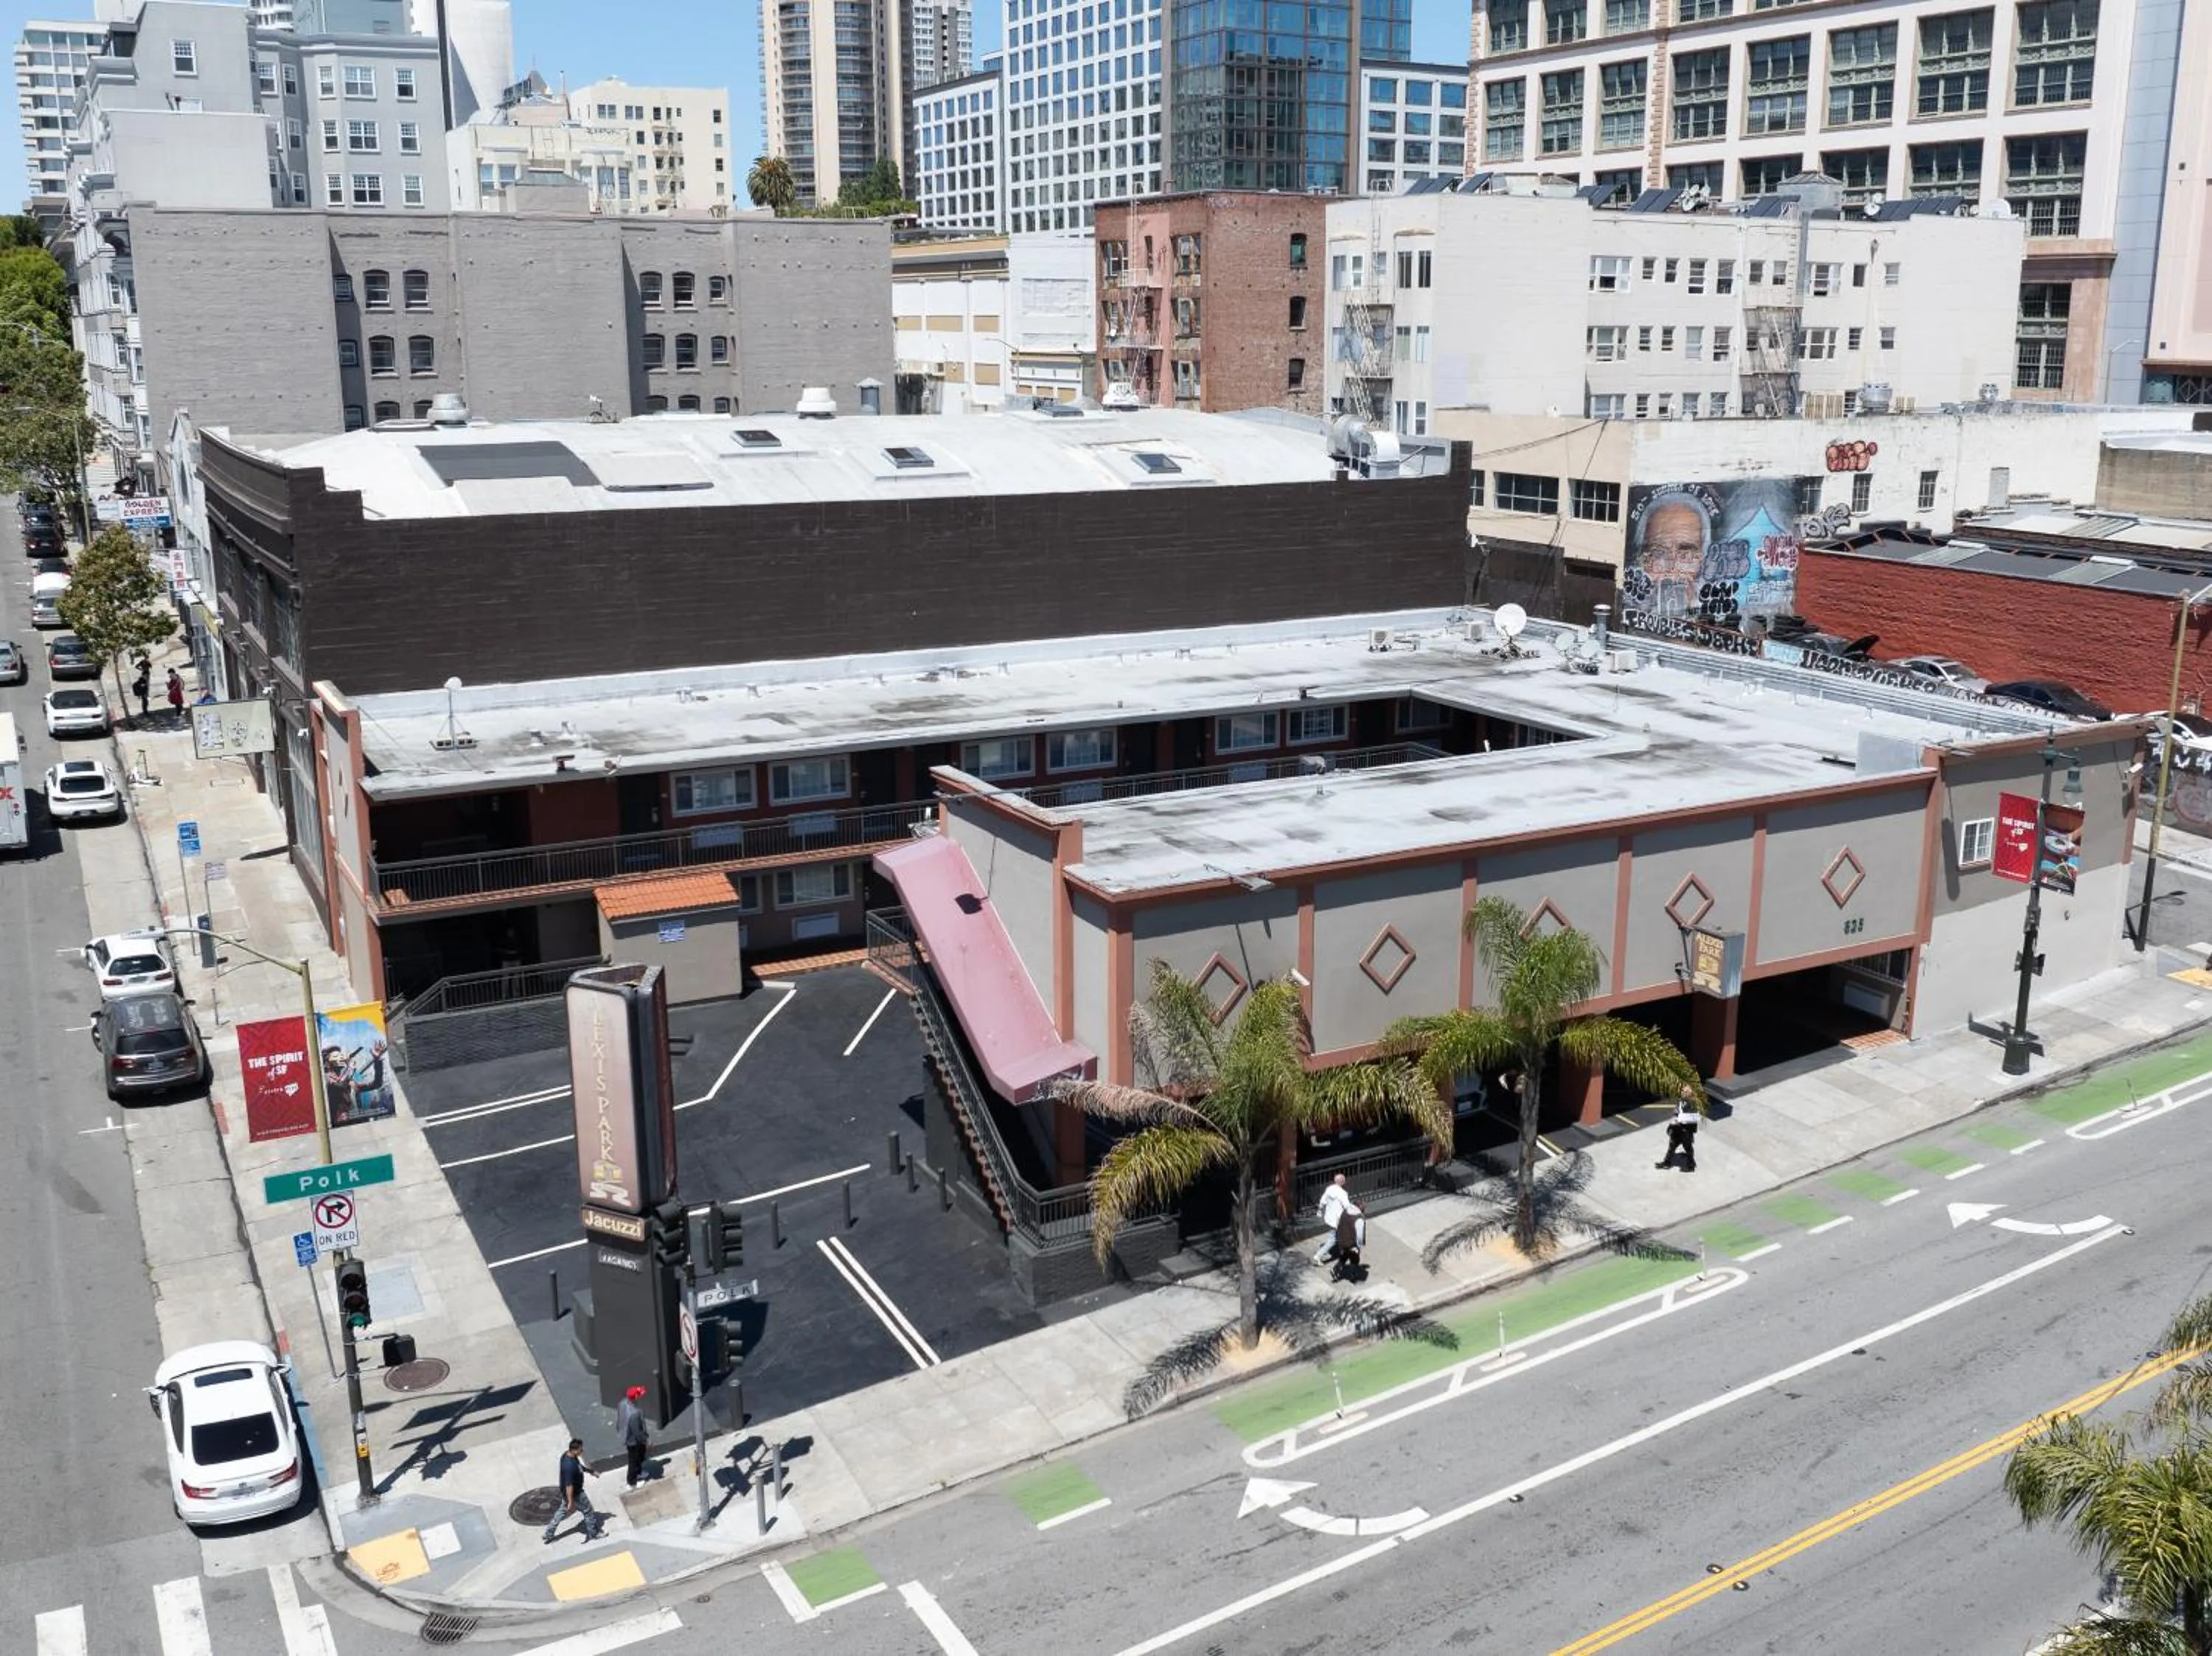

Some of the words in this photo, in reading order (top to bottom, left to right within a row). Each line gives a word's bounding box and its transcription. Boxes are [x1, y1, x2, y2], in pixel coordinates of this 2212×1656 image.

[123, 508, 164, 517] EXPRESS
[125, 500, 161, 509] GOLDEN
[248, 1057, 268, 1068] THE
[269, 1051, 304, 1065] SPIRIT
[275, 1064, 288, 1075] SF
[598, 1096, 613, 1161] PARK
[299, 1168, 361, 1192] Polk
[584, 1208, 641, 1238] Jacuzzi
[319, 1235, 332, 1246] ON
[335, 1231, 355, 1242] RED
[602, 1253, 638, 1270] VACANCY
[703, 1287, 752, 1304] POLK
